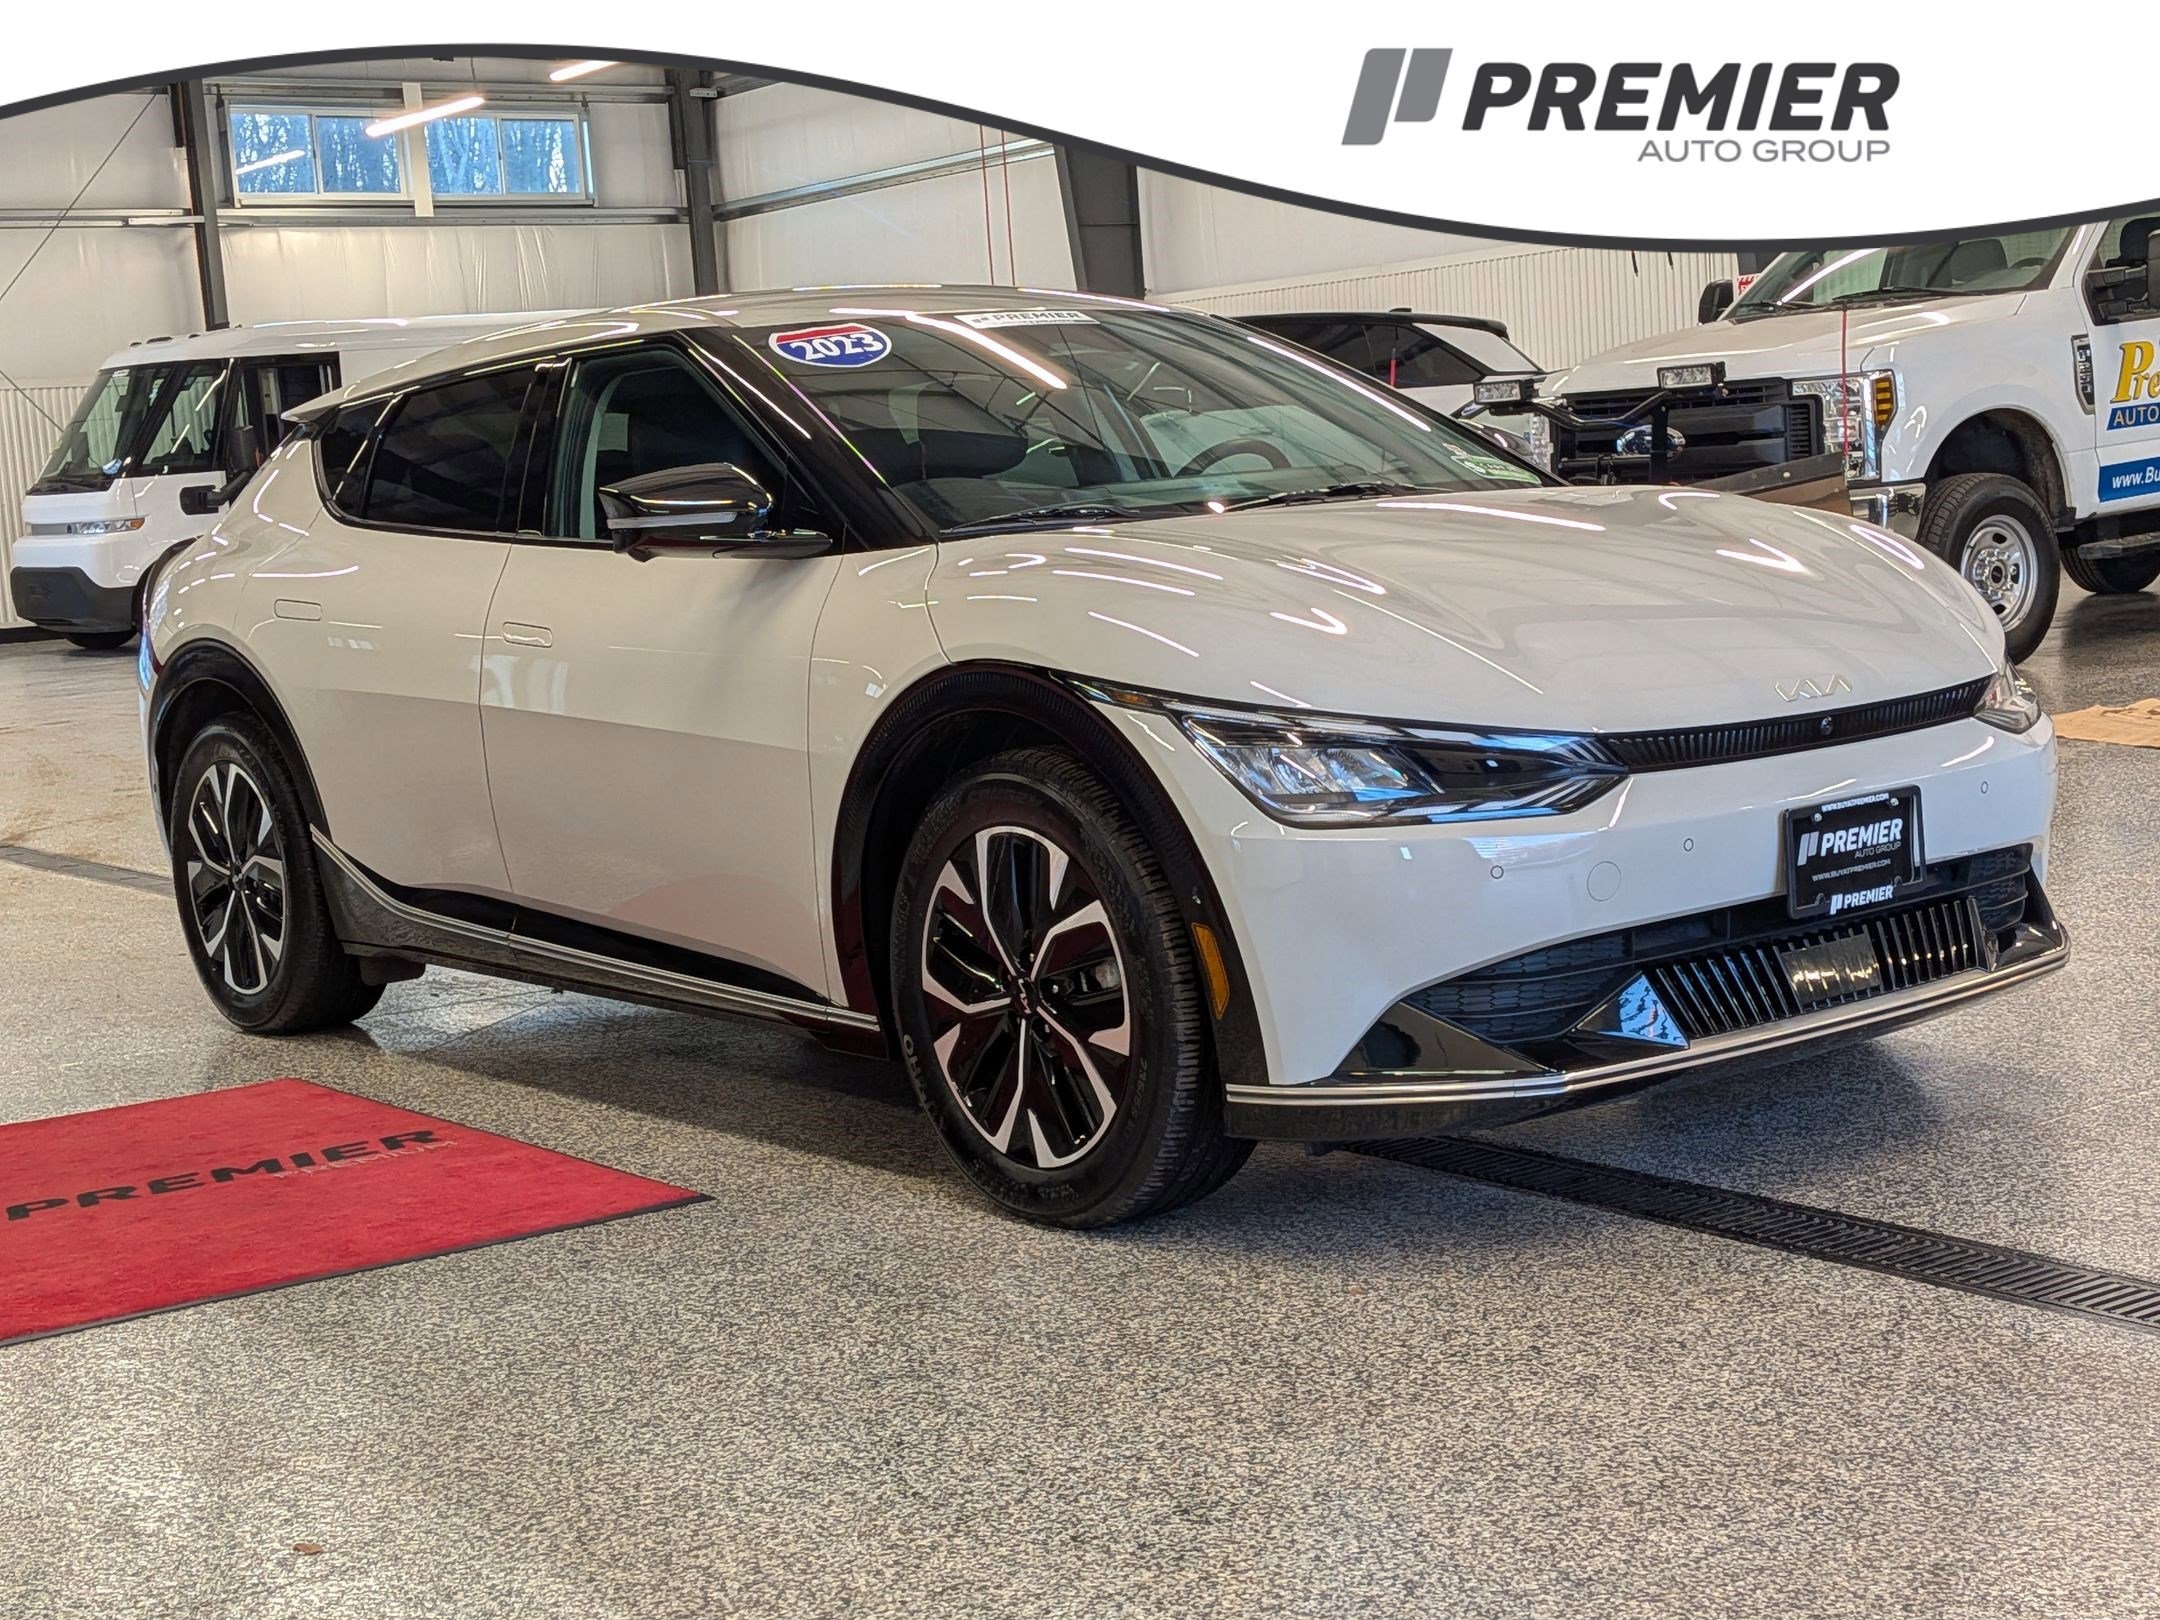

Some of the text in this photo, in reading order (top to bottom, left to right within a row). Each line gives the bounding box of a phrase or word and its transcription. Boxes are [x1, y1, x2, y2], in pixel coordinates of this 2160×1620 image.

[992, 311, 1082, 321] PREMIER
[789, 333, 884, 361] 2023
[2113, 405, 2160, 427] AUTO
[1773, 671, 1853, 702] KIA
[1820, 818, 1904, 857] PREMIER
[1854, 841, 1902, 859] AUTO GROUP
[1843, 884, 1894, 909] PREMIER
[6, 1130, 441, 1221] PREMIER
